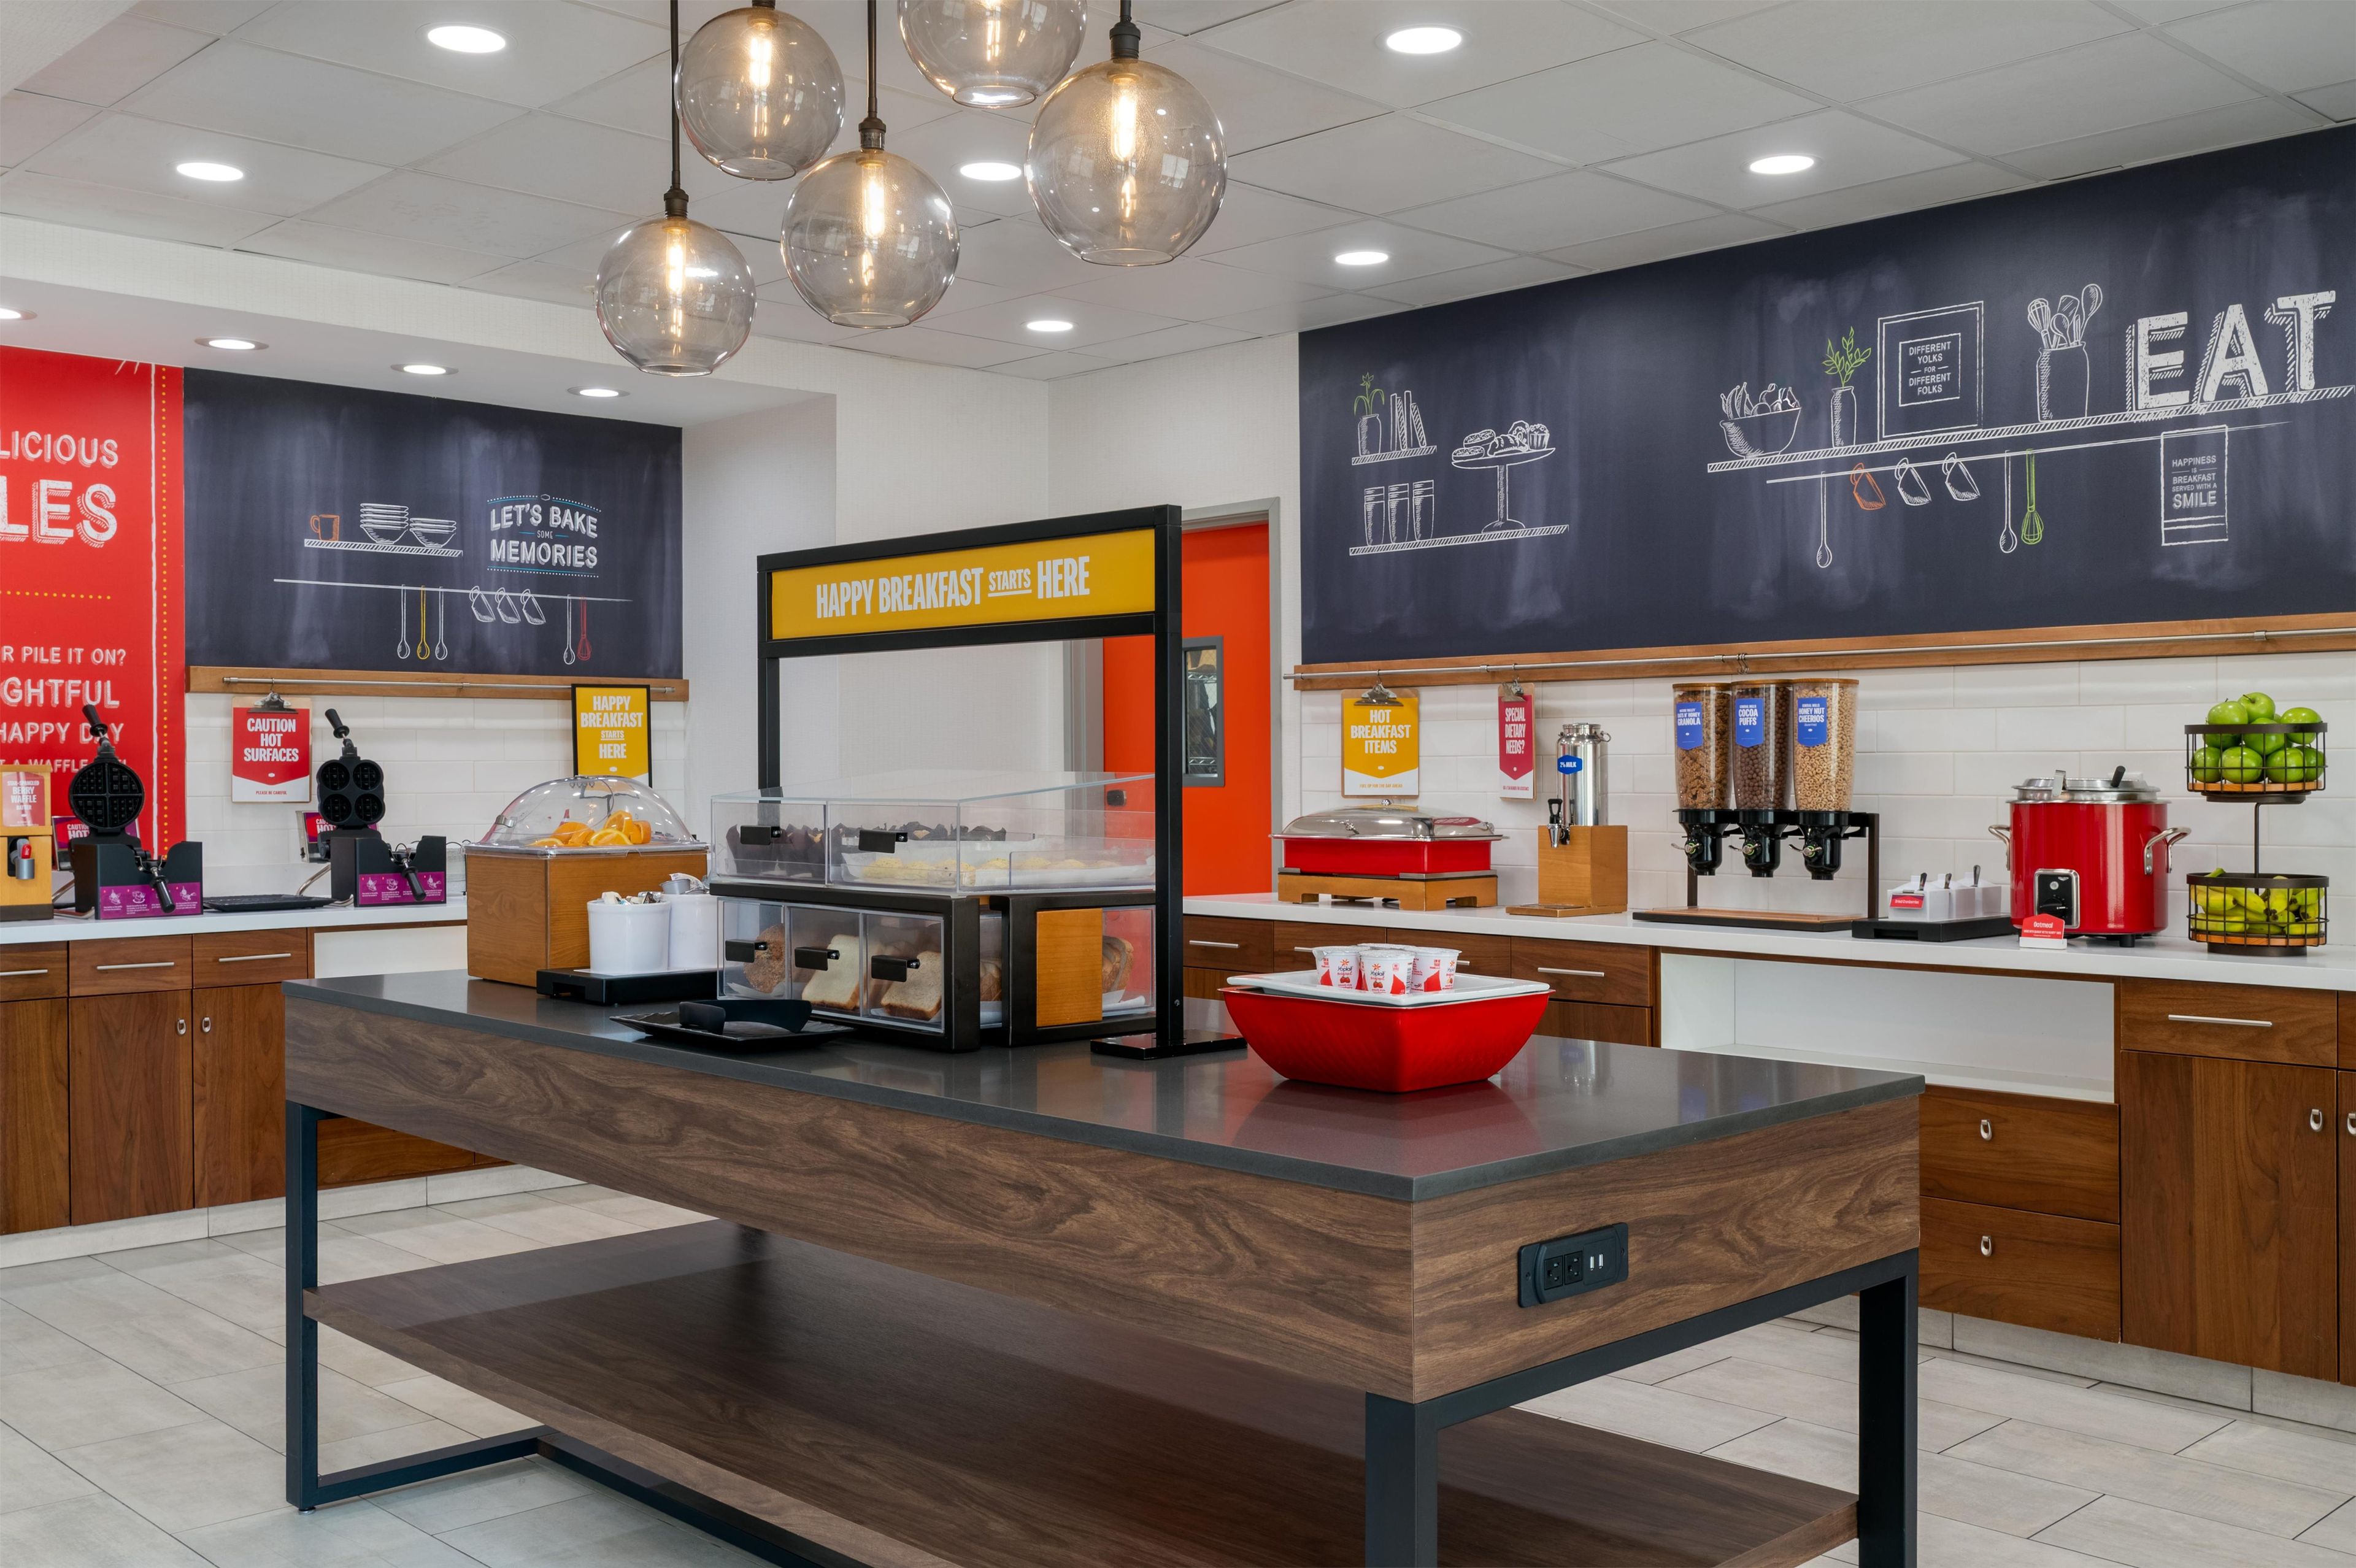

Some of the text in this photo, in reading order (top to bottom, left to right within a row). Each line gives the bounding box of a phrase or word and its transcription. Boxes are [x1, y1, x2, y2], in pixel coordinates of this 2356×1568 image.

[1909, 341, 1952, 356] DIFFERENT
[2127, 290, 2336, 412] EAT
[1917, 353, 1943, 365] YOLKS
[1909, 372, 1952, 387] DIFFERENT
[1917, 384, 1942, 396] FOLKS
[2172, 455, 2217, 468] HAPPINESS
[2173, 472, 2217, 485] BREAKFAST
[2173, 490, 2217, 510] SMILE
[490, 503, 598, 539] LET'S BAKE
[537, 530, 553, 539] SOME
[490, 539, 598, 569] MEMORIES
[816, 555, 1090, 619] HAPPY BREAKFAST STARTS HERE
[21, 645, 62, 664] PILE
[67, 647, 85, 664] IT
[91, 648, 127, 666] ON?
[1, 676, 120, 709] GHTFUL
[592, 695, 631, 711] HAPPY
[580, 712, 644, 728] BREAKFAST
[1369, 709, 1392, 723] HOT
[1505, 707, 1526, 722] SPECIAL
[1738, 709, 1758, 717] COCOA
[247, 718, 296, 732] CAUTION
[1677, 717, 1701, 726] GRANOLA
[1739, 717, 1757, 726] PUFFS
[79, 722, 125, 745] DY
[601, 730, 625, 739] STARTS
[1350, 724, 1412, 739] BREAKFAST
[1505, 724, 1526, 739] DIETARY
[260, 733, 283, 747] HOT
[1364, 740, 1398, 754] ITEMS
[1506, 740, 1525, 755] NEEDS?
[243, 747, 299, 762] SURFACES
[598, 743, 627, 759] HERE
[12, 786, 35, 794] BERRY
[11, 794, 37, 803] WAFFLE
